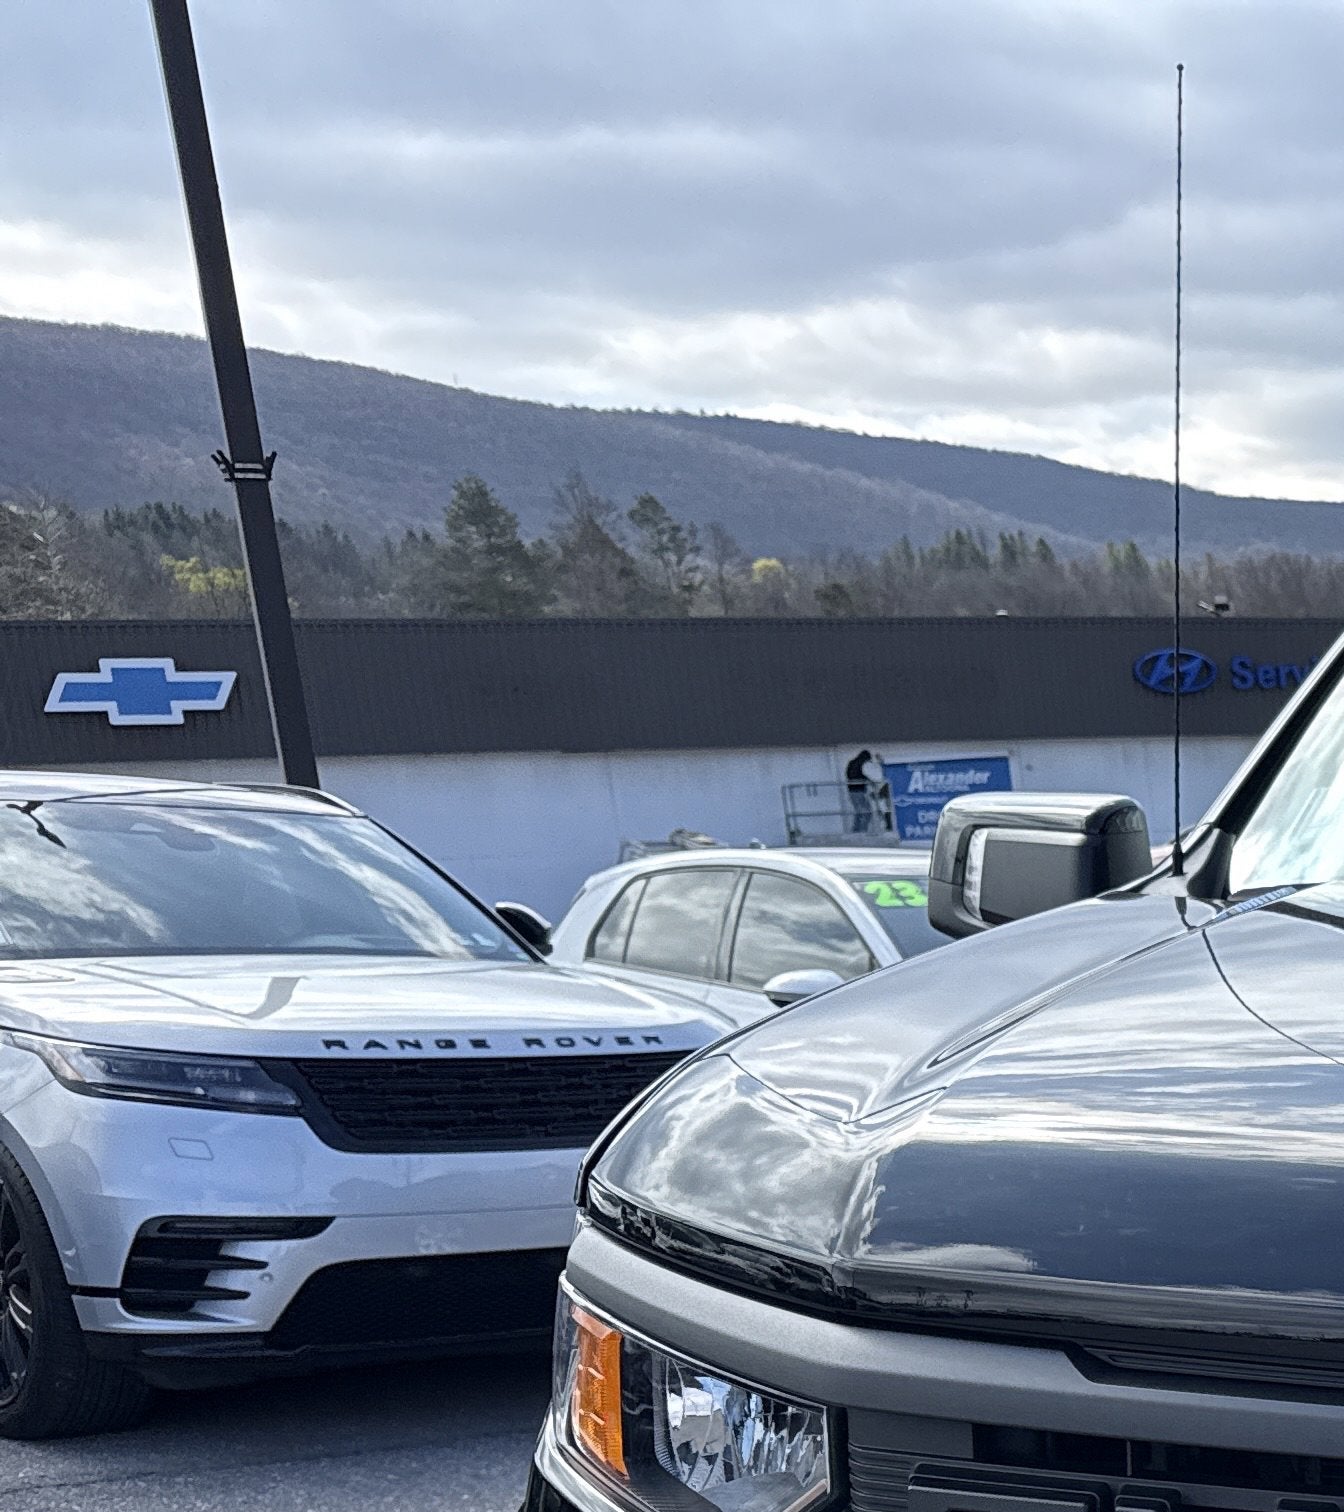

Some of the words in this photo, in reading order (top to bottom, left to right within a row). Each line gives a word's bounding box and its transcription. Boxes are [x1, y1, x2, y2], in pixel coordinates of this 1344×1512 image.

[863, 880, 929, 907] 23
[321, 1038, 492, 1051] RANGE
[522, 1035, 664, 1049] ROVER
